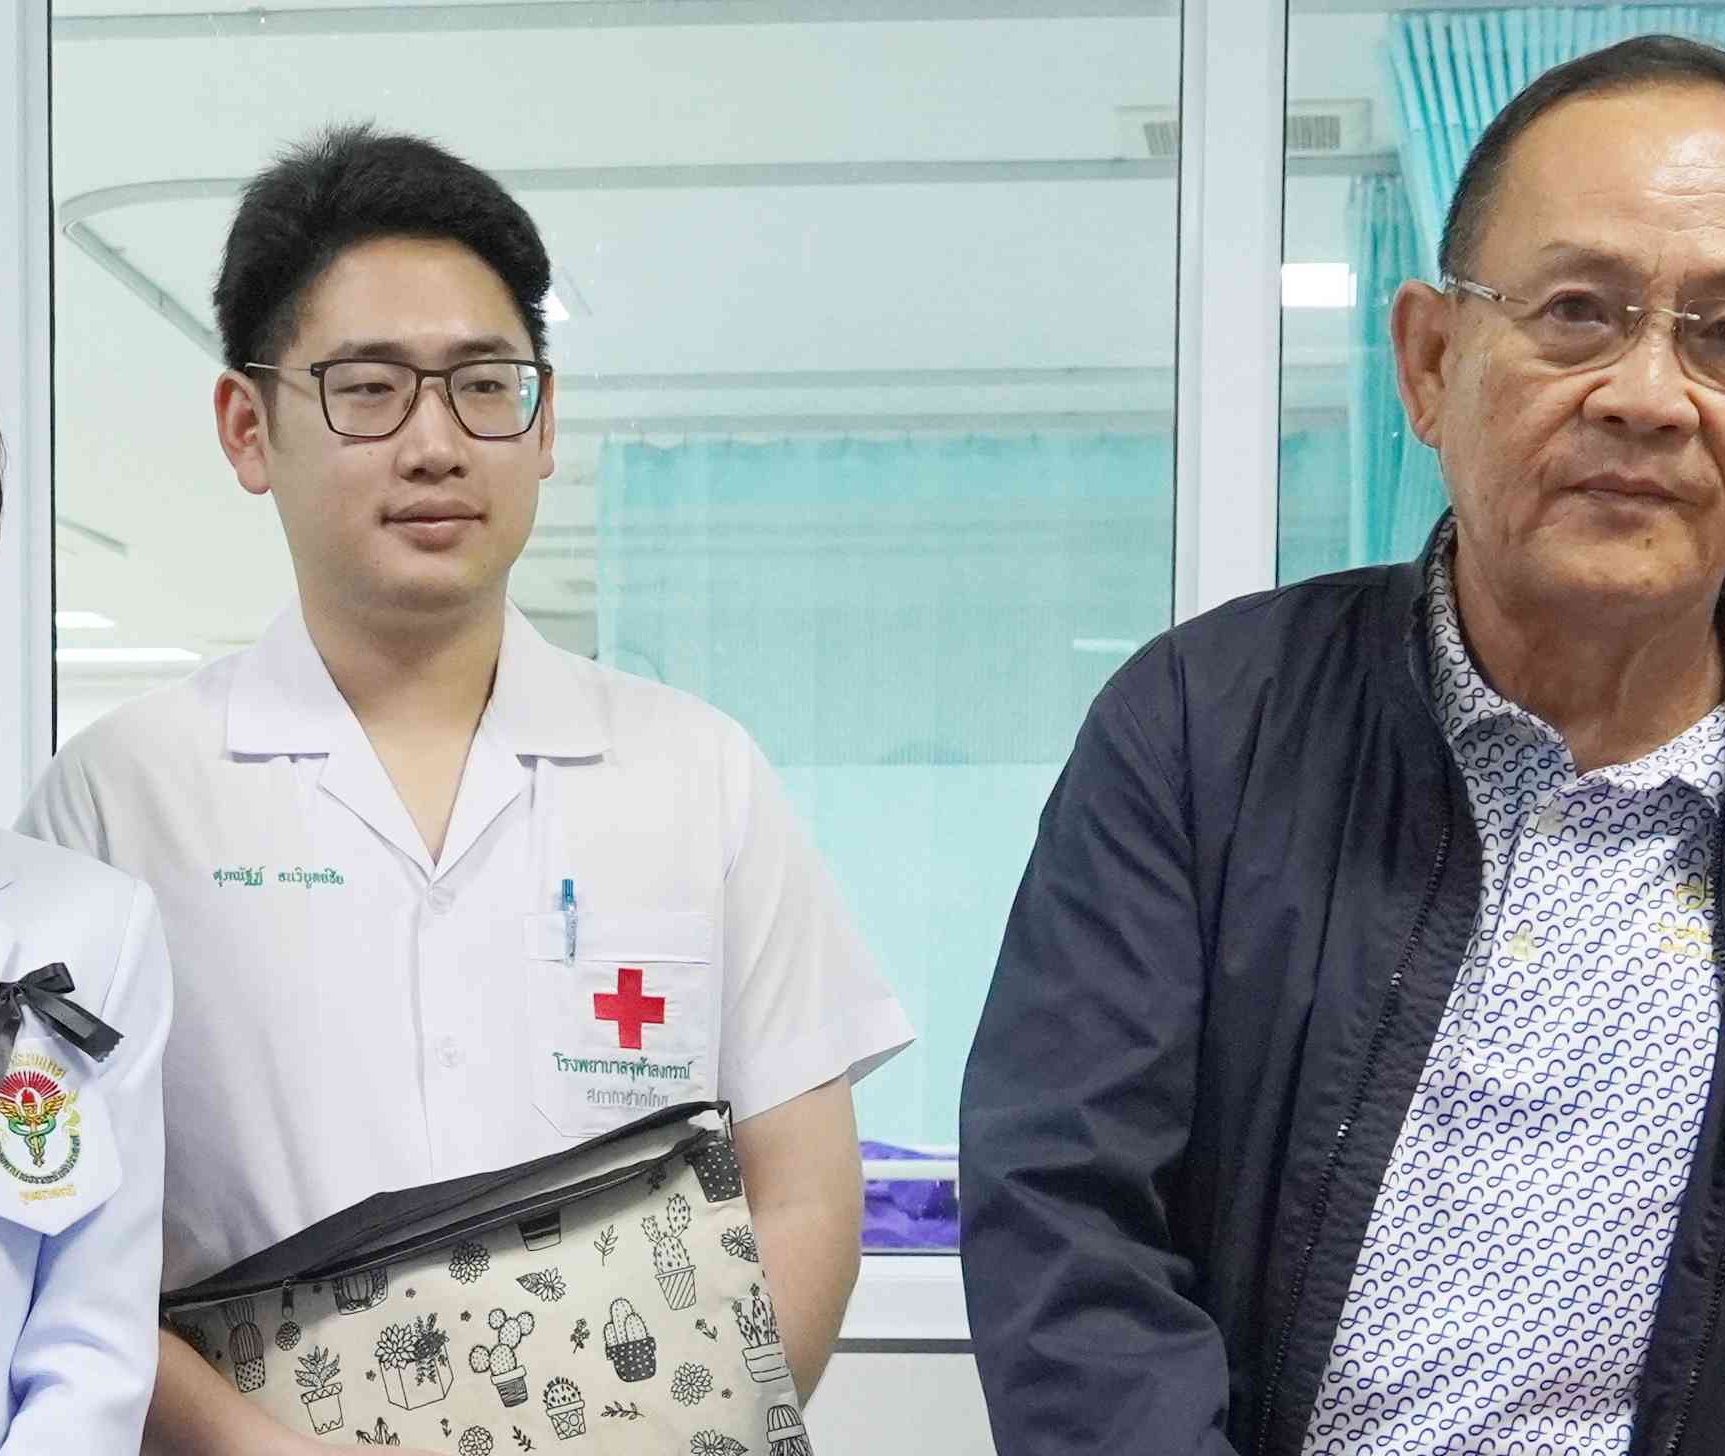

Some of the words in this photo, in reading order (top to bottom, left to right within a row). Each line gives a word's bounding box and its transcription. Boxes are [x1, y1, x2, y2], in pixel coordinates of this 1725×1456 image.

[553, 1052, 695, 1083] โรงพยาบาลจุฬาลงกรณ์
